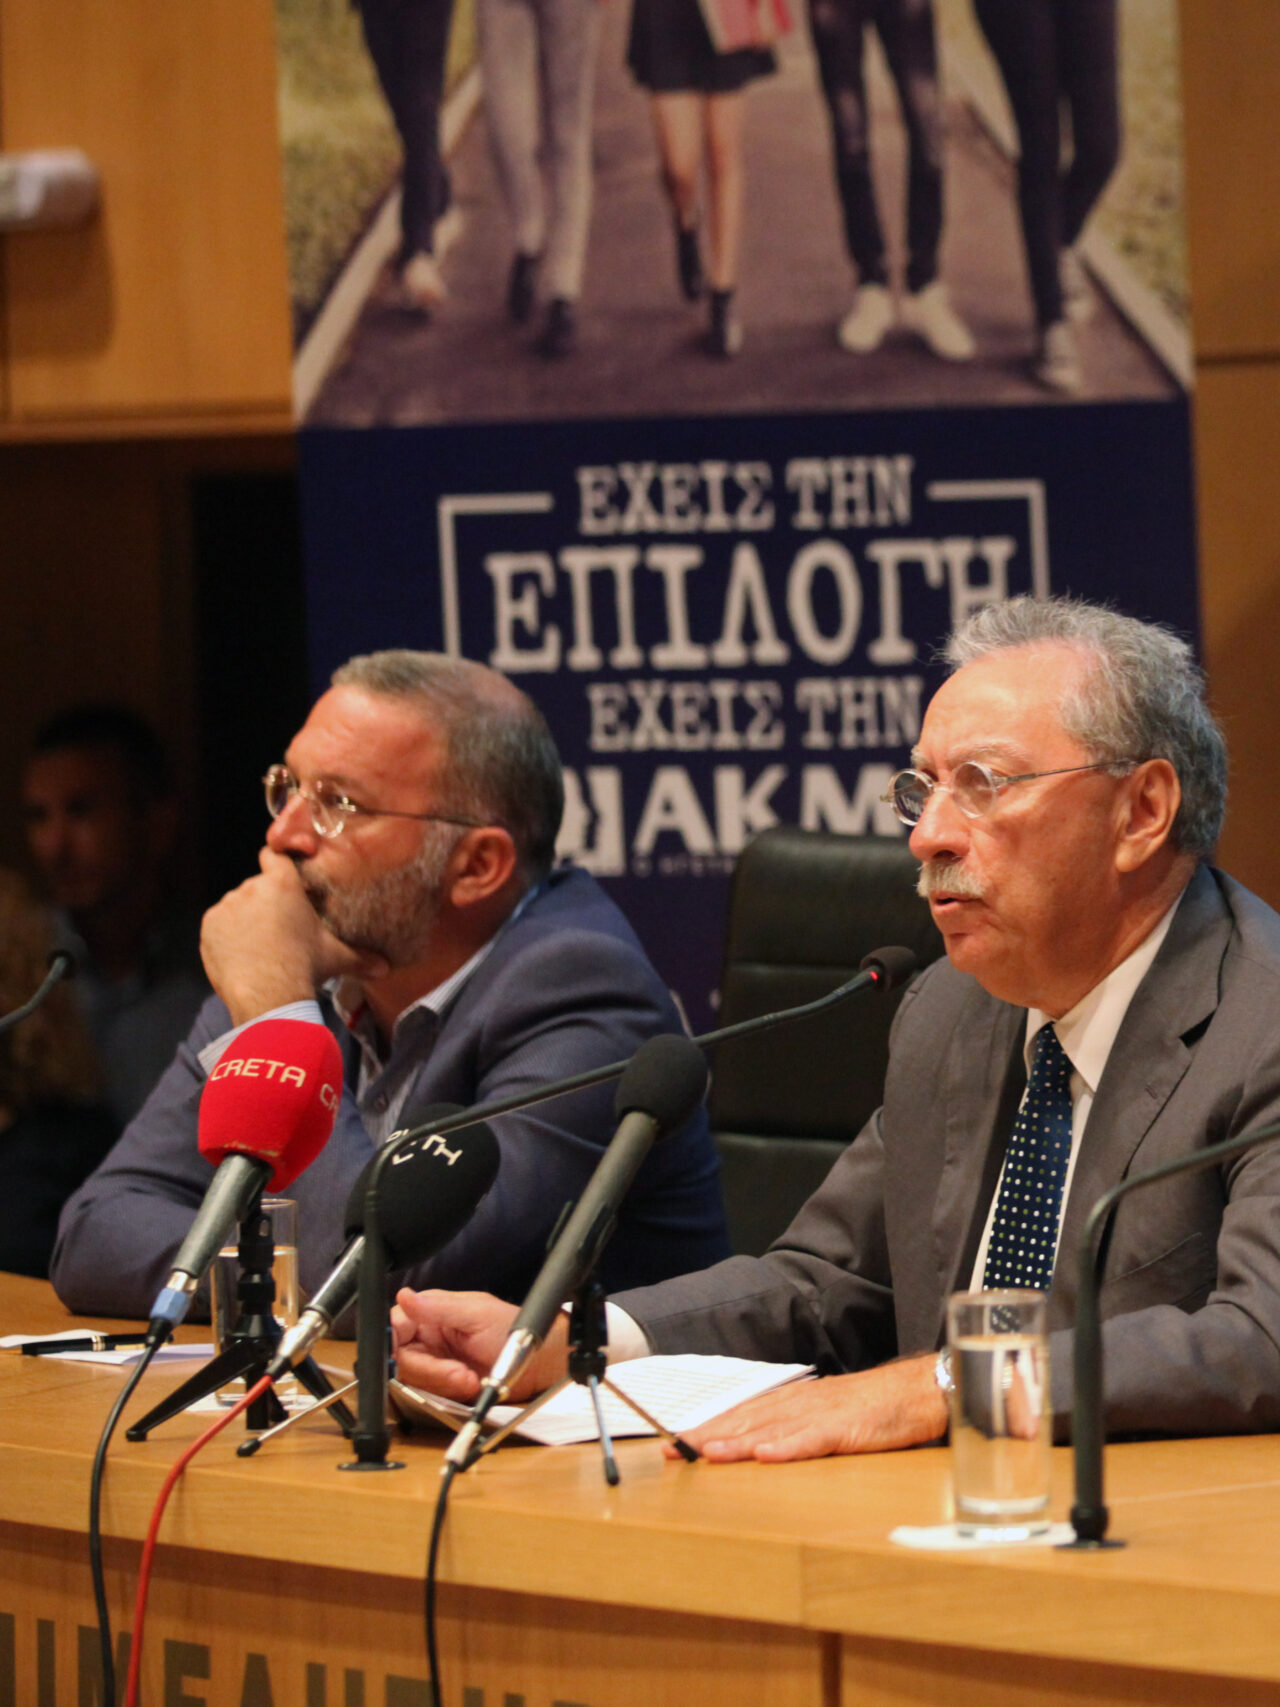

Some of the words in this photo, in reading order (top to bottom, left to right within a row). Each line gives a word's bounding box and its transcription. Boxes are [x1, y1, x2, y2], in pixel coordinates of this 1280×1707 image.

[576, 460, 775, 535] ΕΧΕΙΣ
[785, 454, 914, 530] ΤΗΝ
[484, 536, 1016, 673] ΕΠΙΛΟΓΗ
[586, 679, 786, 752] ΕΧΕΙΣ
[795, 676, 923, 749] ΤΗΝ
[633, 763, 906, 856] ΑΚΜ
[210, 1058, 307, 1088] CRETA
